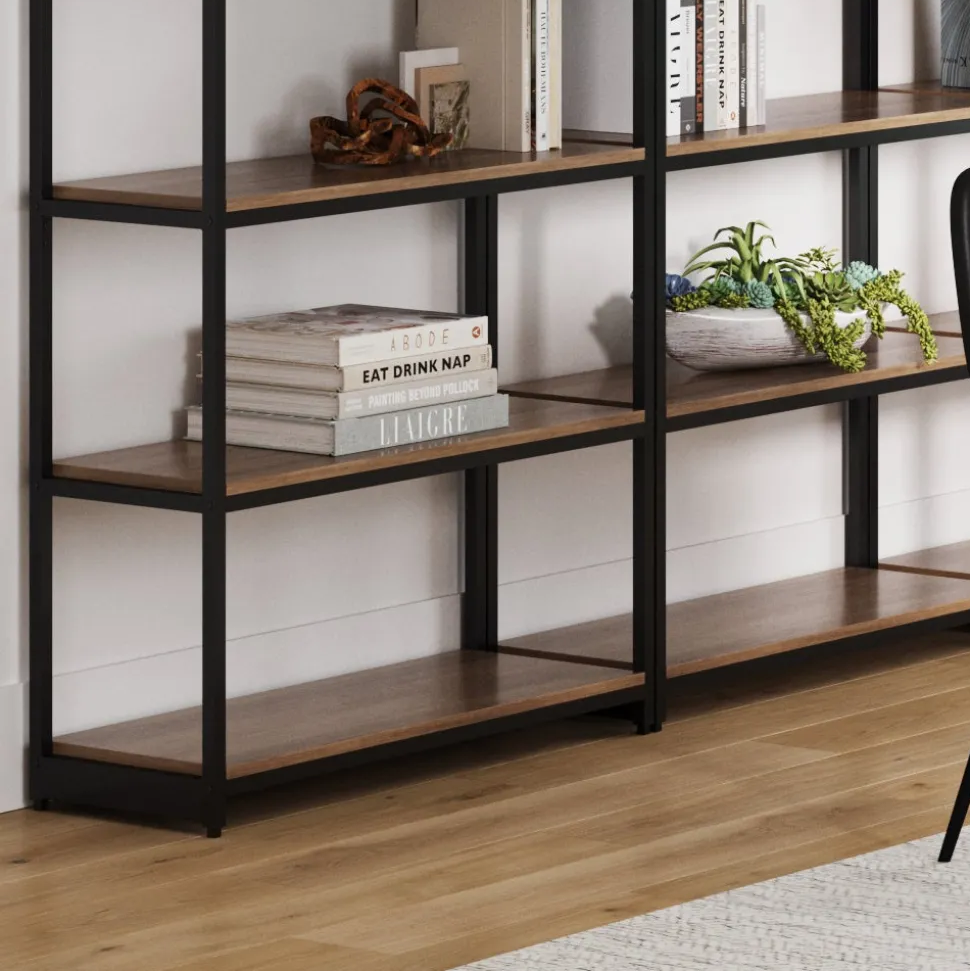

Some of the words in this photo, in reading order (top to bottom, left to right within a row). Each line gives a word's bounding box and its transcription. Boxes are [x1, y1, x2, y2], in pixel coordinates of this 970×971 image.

[696, 27, 704, 123] WEARSTLER
[390, 329, 449, 351] ABODE
[362, 367, 389, 384] EAT
[393, 359, 438, 378] DRINK
[442, 354, 471, 370] NAP
[368, 390, 407, 409] PAINTING
[409, 384, 441, 402] BEYOND
[443, 378, 479, 396] POLLOCK
[380, 404, 468, 446] LIAIGRE
